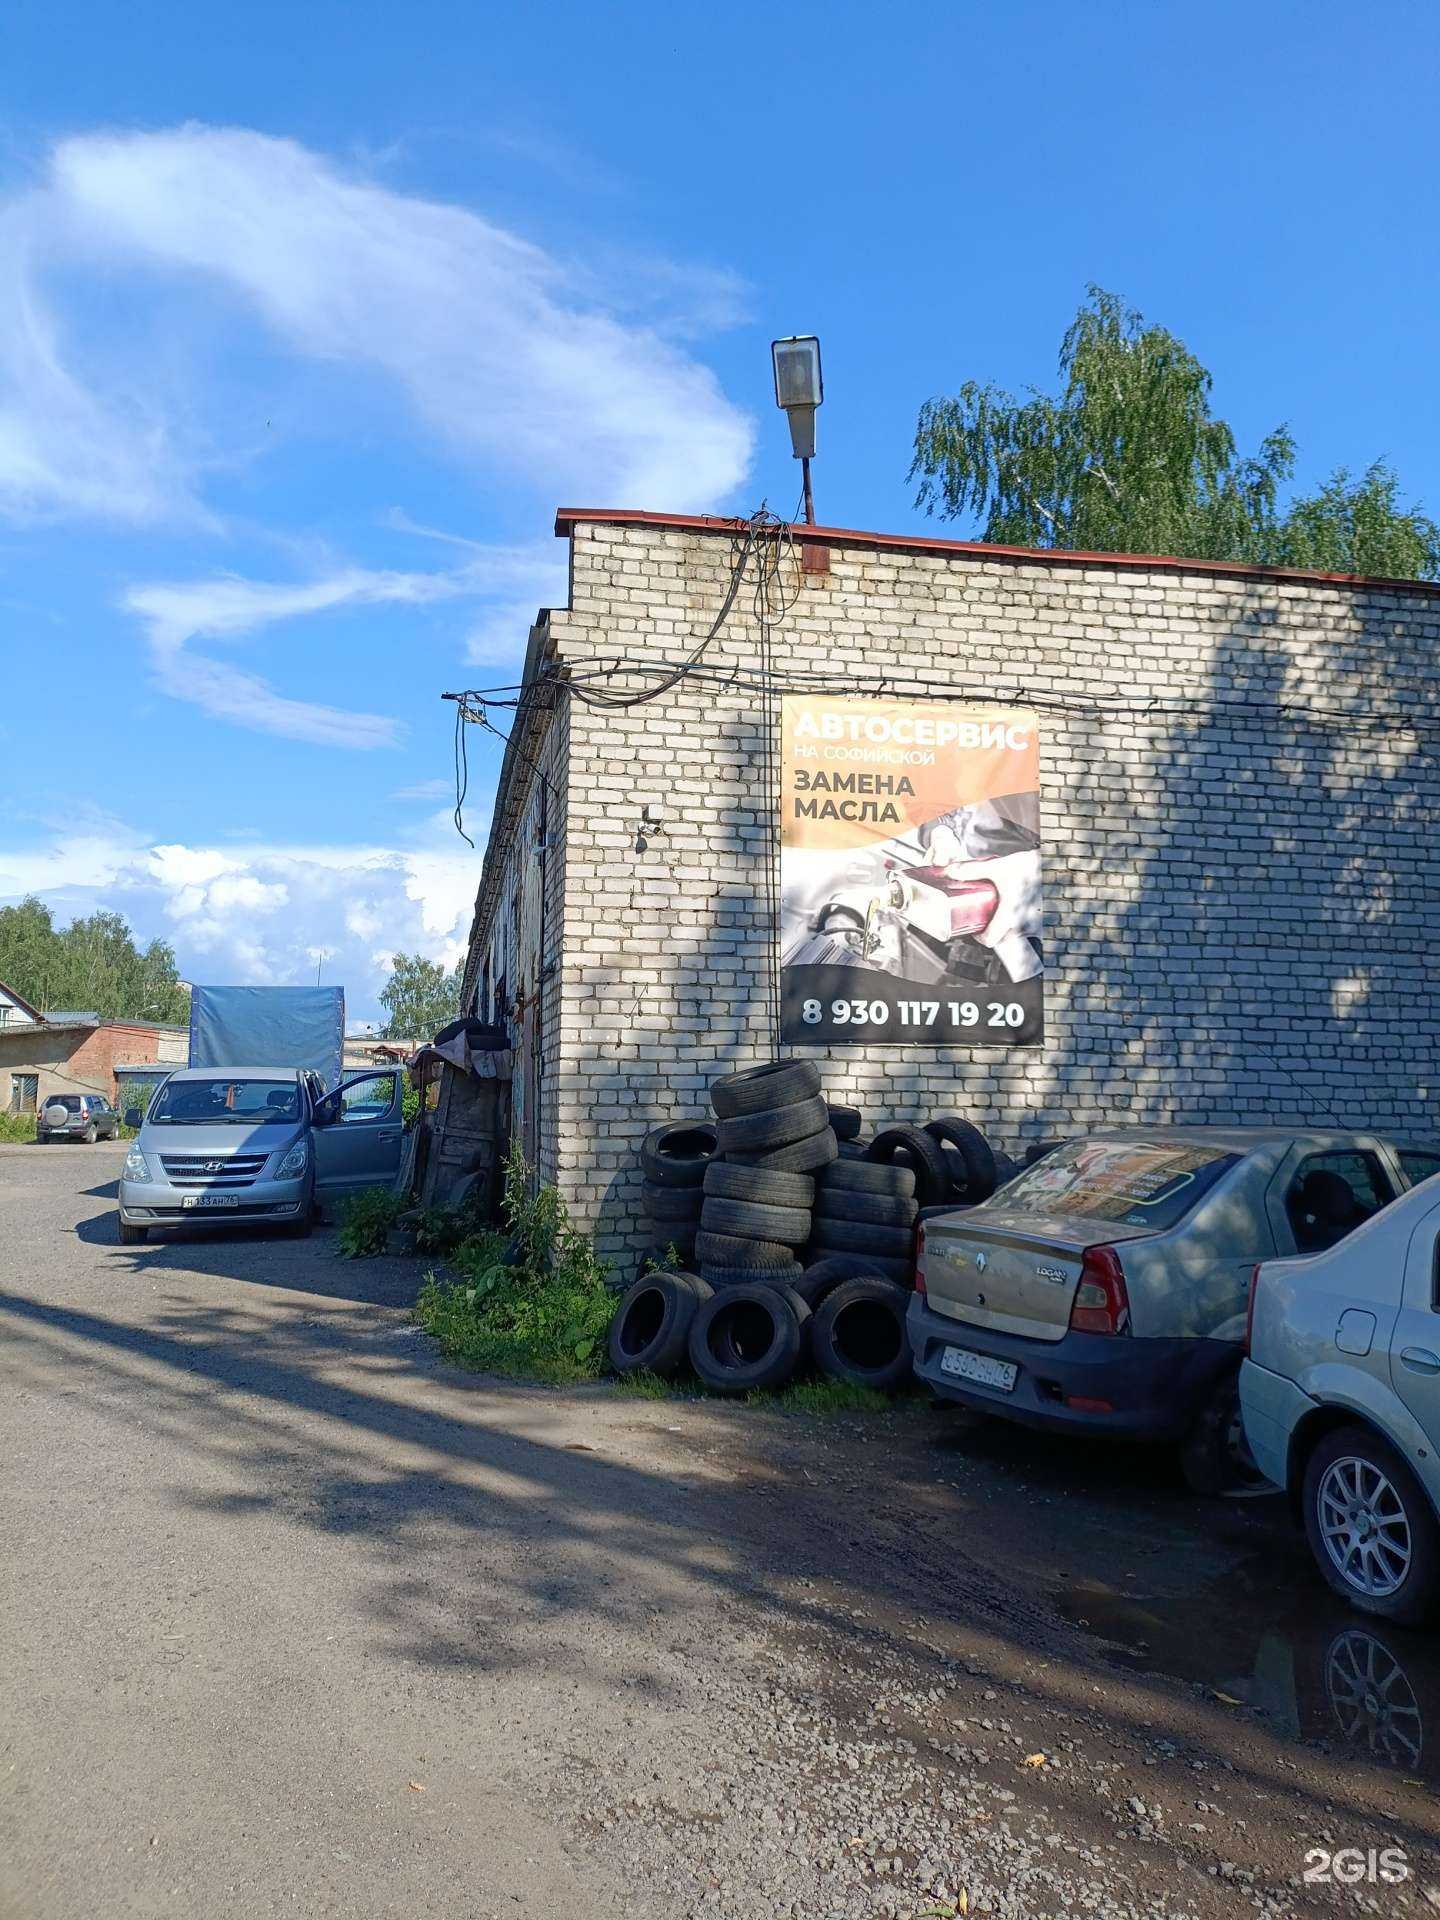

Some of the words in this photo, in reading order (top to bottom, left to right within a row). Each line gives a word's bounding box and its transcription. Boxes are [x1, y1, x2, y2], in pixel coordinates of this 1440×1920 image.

[793, 711, 1029, 751] АВТОСЕРВИС
[794, 743, 818, 758] НА
[823, 745, 936, 766] СОФИЙСКОЙ
[793, 769, 916, 797] ЗАМЕНА
[794, 797, 901, 824] МАСЛА
[802, 998, 823, 1024] 8
[831, 999, 889, 1025] 930
[897, 1001, 940, 1026] 117
[948, 1002, 980, 1027] 19
[986, 1002, 1025, 1028] 20
